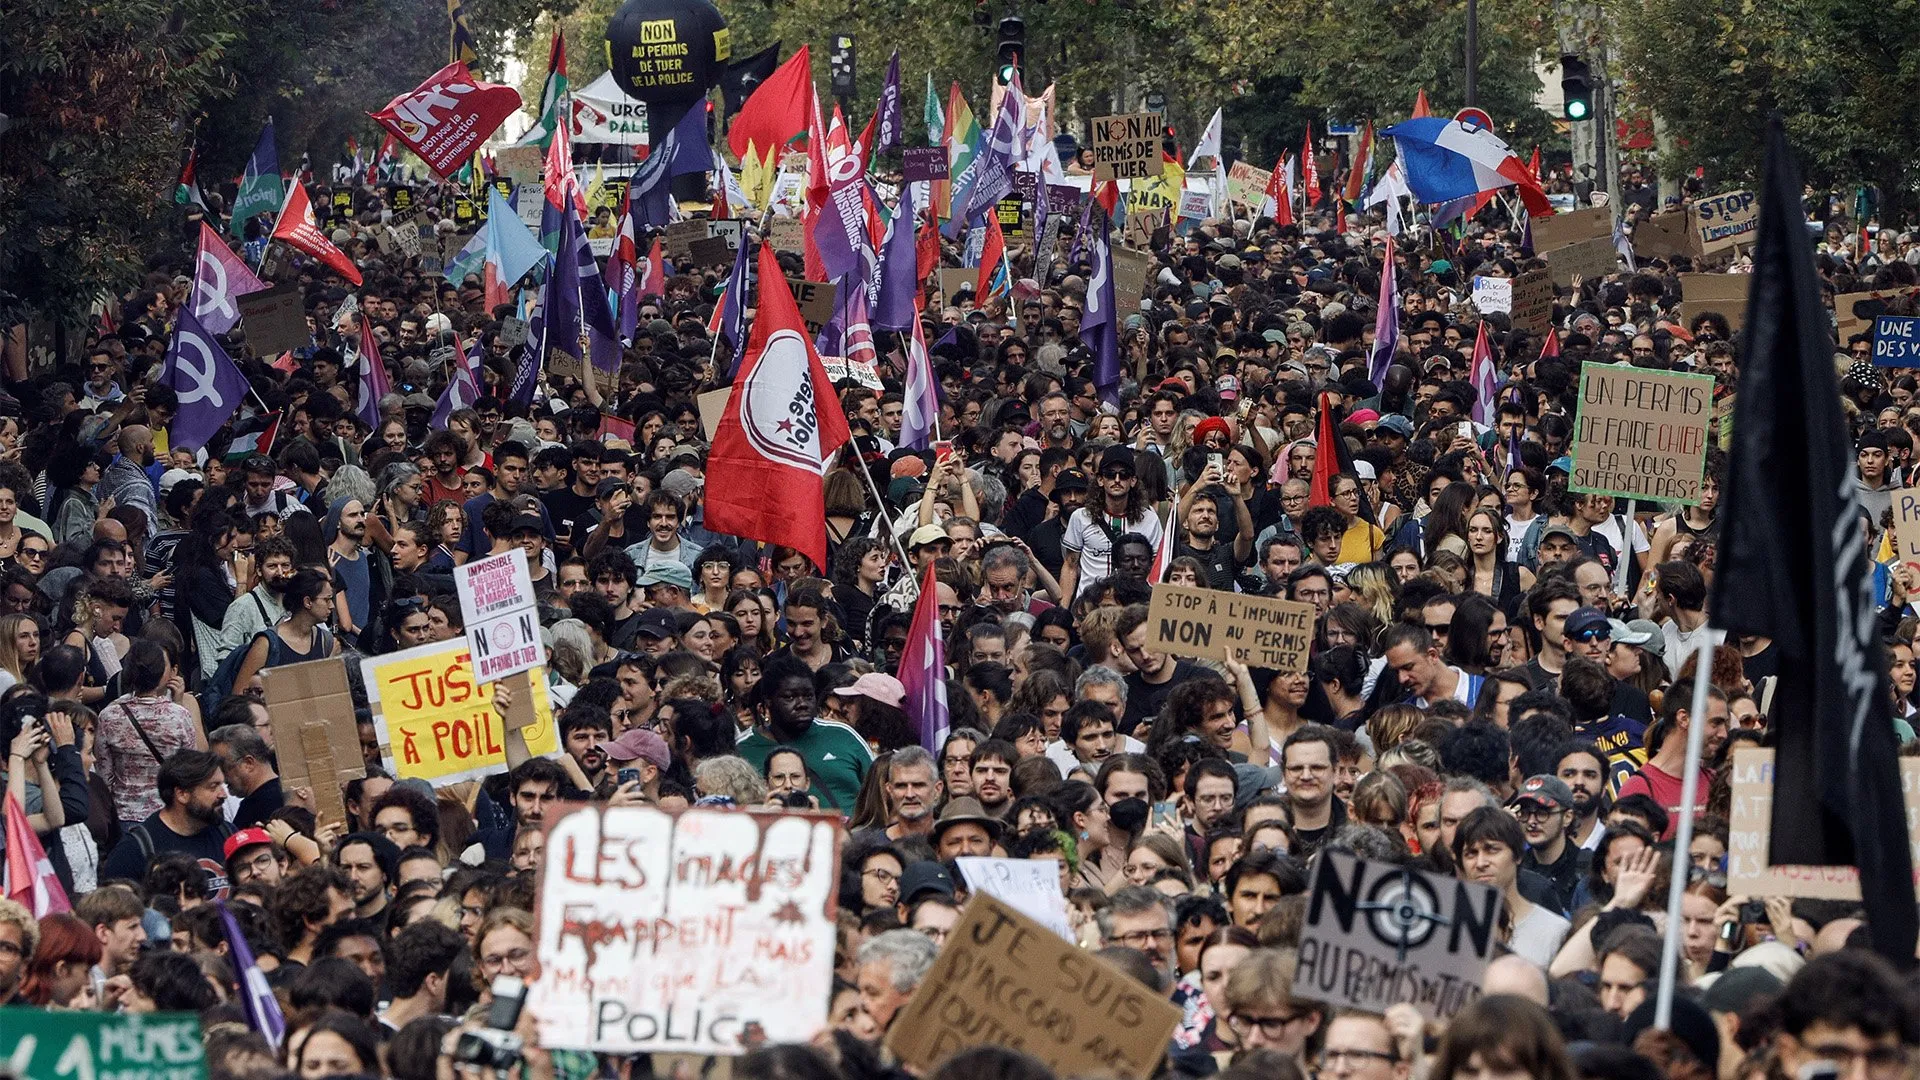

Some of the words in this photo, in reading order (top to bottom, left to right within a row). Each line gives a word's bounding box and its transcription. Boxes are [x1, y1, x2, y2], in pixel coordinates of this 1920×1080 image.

[644, 23, 673, 41] NON
[632, 46, 645, 58] AU
[647, 43, 689, 57] PERMIS
[640, 60, 653, 72] DE
[654, 58, 682, 71] TUER
[631, 76, 643, 87] DE
[645, 74, 656, 86] LA
[658, 72, 694, 86] POLICE
[449, 114, 461, 125] la
[1096, 118, 1140, 142] NON
[1144, 116, 1160, 137] AU
[1136, 141, 1153, 158] DE
[1111, 161, 1148, 178] TUER
[1699, 191, 1754, 220] STOP
[708, 224, 735, 235] Tuer
[832, 190, 862, 252] INSOUMISE
[1880, 321, 1914, 337] UNE
[1876, 340, 1906, 357] DES
[1584, 376, 1614, 405] UN
[1624, 380, 1703, 415] PERMIS
[1579, 416, 1601, 445] DE
[1604, 418, 1654, 450] FAIRE
[1658, 423, 1704, 455] CHIER
[1631, 454, 1677, 477] VOUS
[1574, 468, 1652, 494] SUFFISAIT
[1656, 477, 1698, 499] PAS?
[467, 554, 513, 577] IMPOSSIBLE
[477, 565, 516, 584] NEUTRALISER
[474, 596, 485, 608] EN
[486, 586, 517, 604] MARCHE
[486, 576, 513, 592] PEUPLE
[1165, 593, 1201, 610] STOP
[1207, 595, 1217, 614] À
[1229, 602, 1308, 630] L'IMPUNITÉ
[474, 614, 534, 657] NON
[1159, 619, 1212, 647] NON
[1226, 626, 1244, 640] AU
[1254, 630, 1306, 652] PERMIS
[480, 660, 489, 677] AU
[489, 651, 512, 675] PERMIS
[513, 651, 521, 667] DE
[521, 646, 538, 666] TUER
[1236, 648, 1250, 660] DE
[1260, 650, 1299, 668] TUER
[399, 726, 421, 764] À
[565, 835, 647, 889] LES
[1308, 847, 1498, 958] NON
[754, 938, 813, 962] MAIS
[972, 905, 1038, 969] JE
[1051, 952, 1145, 1029] SUIS
[1294, 937, 1341, 992] AU
[945, 946, 1077, 1044] D'ACCORD
[597, 999, 740, 1044] POLiC
